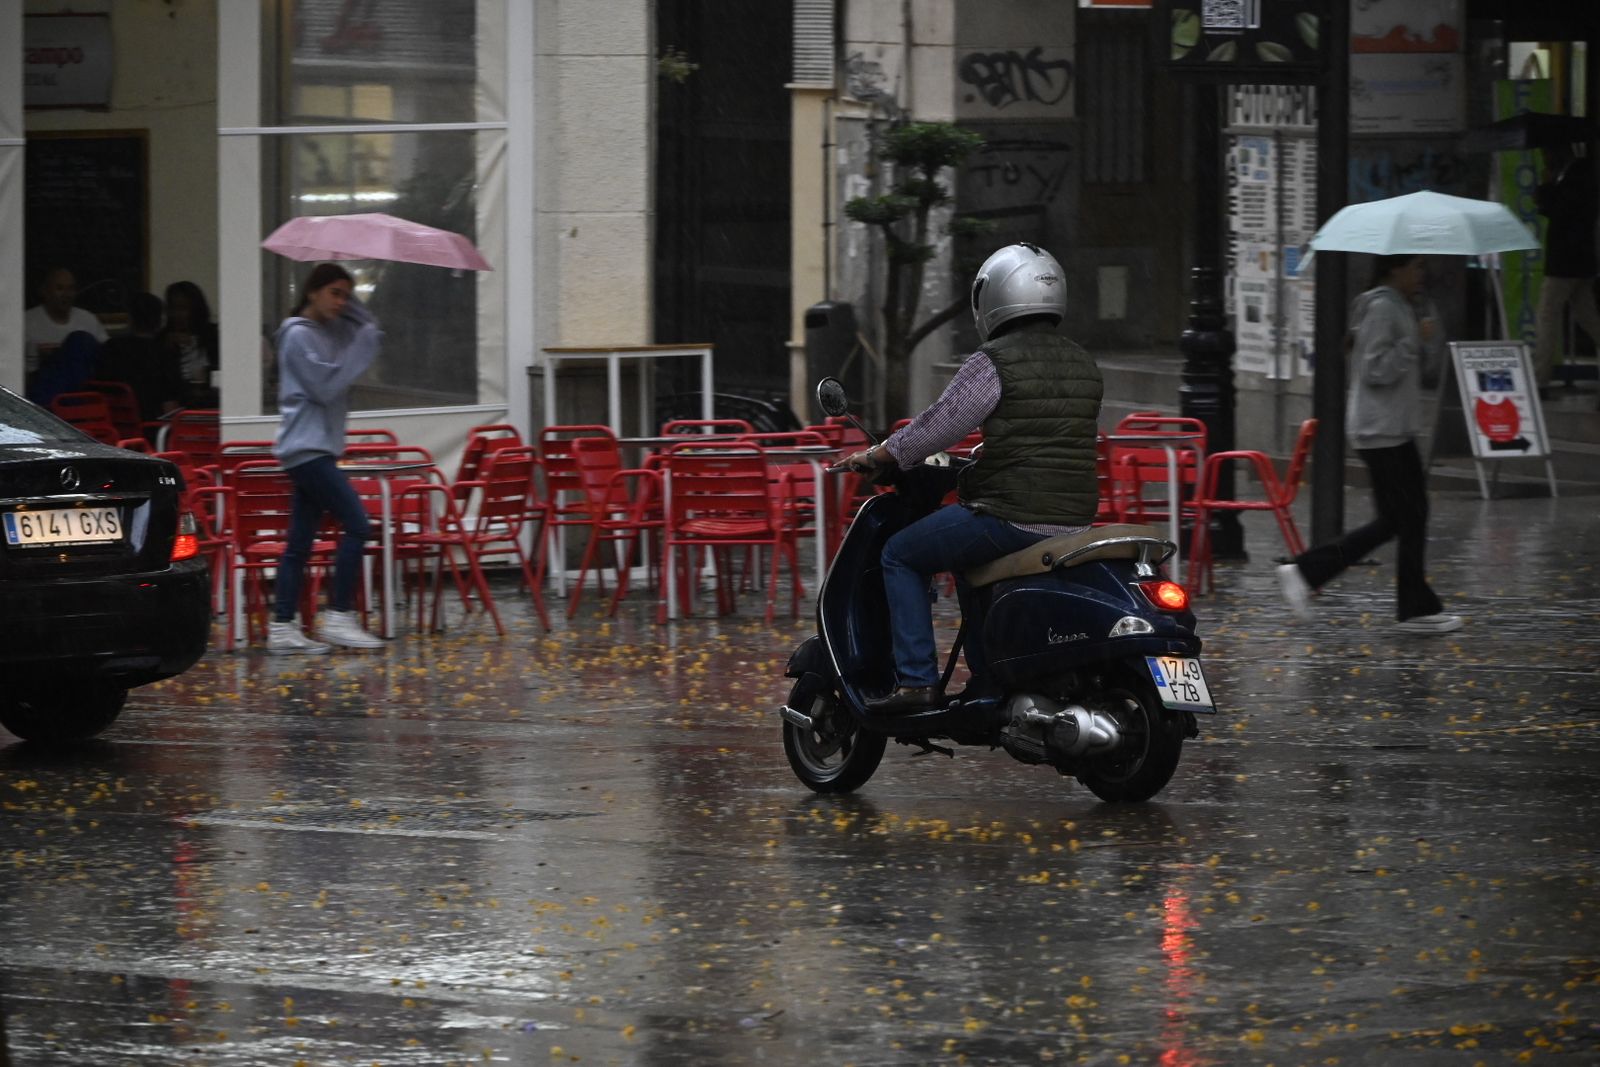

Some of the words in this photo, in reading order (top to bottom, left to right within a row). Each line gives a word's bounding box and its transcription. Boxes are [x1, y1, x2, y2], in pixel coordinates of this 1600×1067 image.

[20, 513, 72, 538] 6141
[80, 511, 118, 535] GXS
[1047, 626, 1089, 645] Vespa
[1162, 660, 1201, 681] 1749
[1168, 682, 1201, 702] FZB
